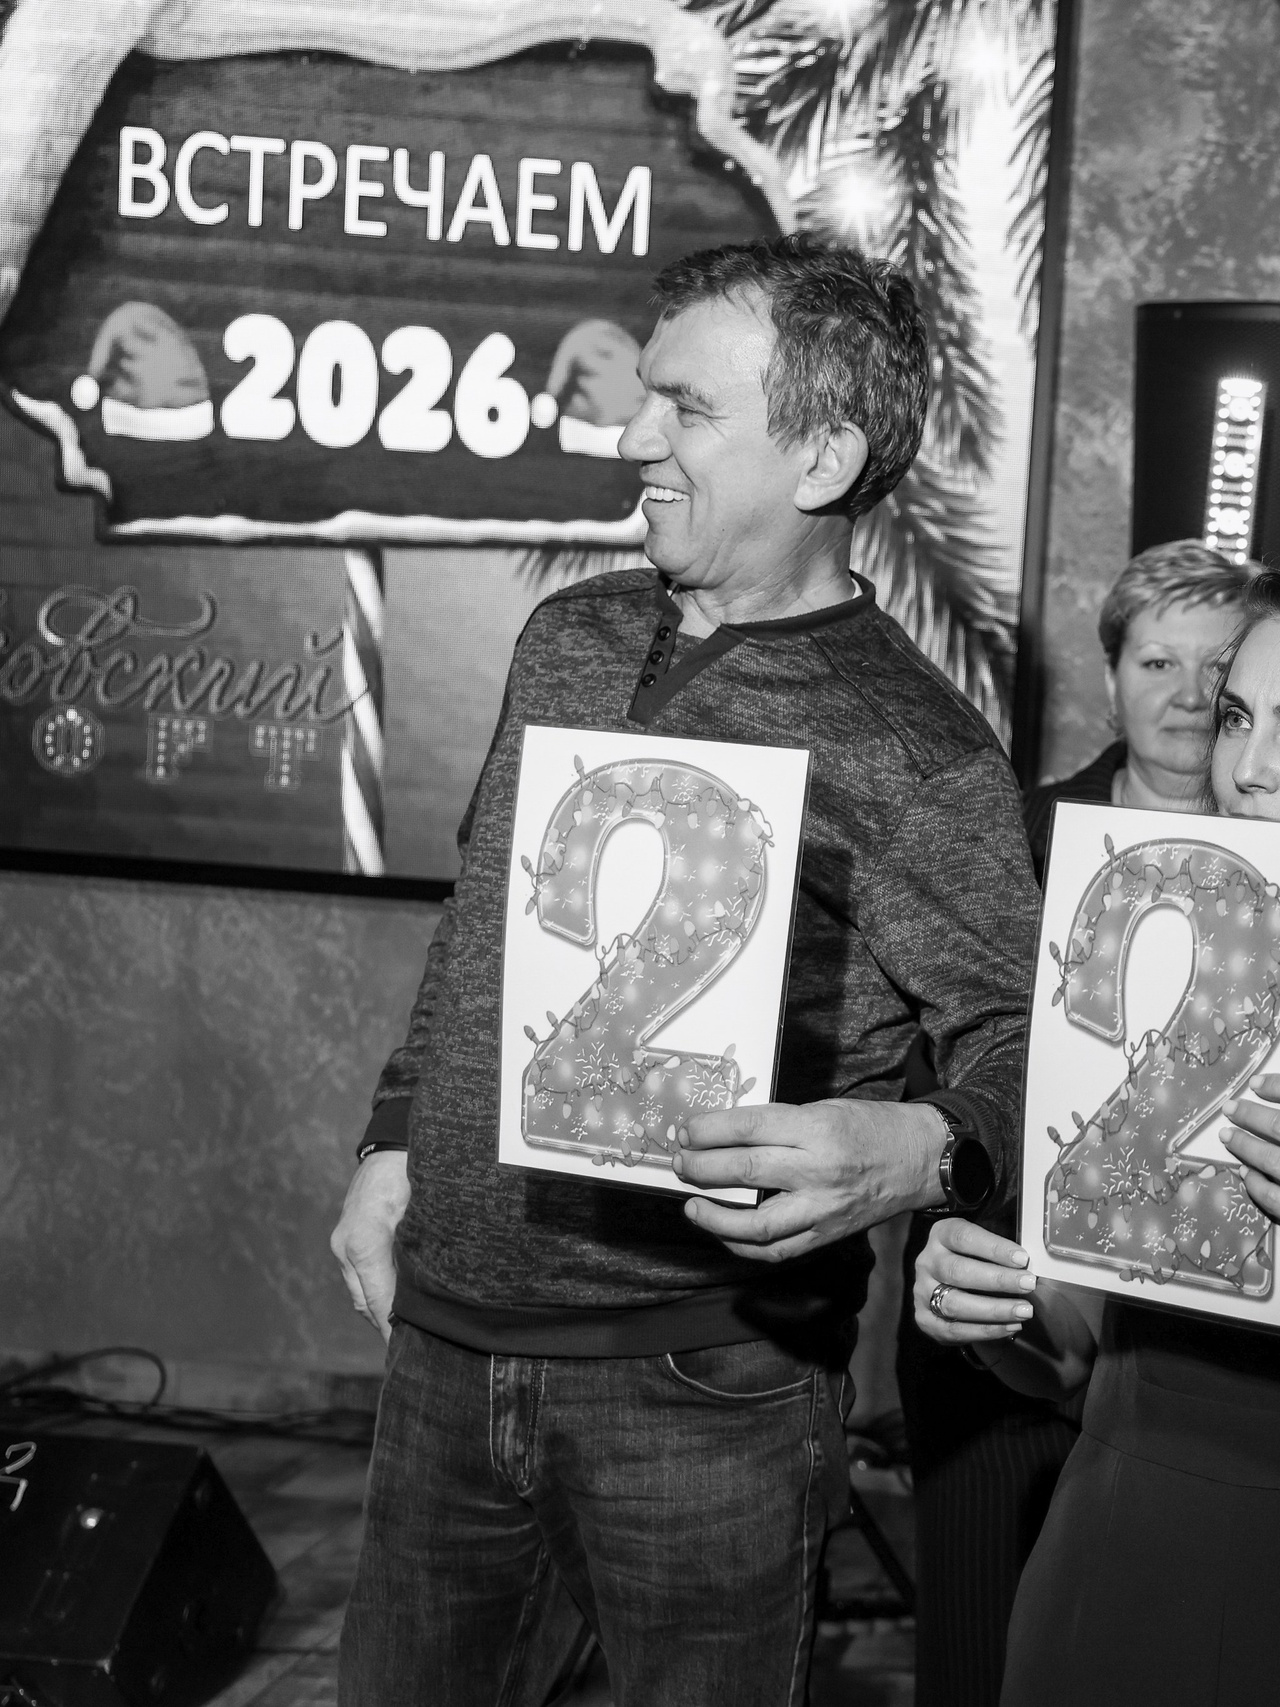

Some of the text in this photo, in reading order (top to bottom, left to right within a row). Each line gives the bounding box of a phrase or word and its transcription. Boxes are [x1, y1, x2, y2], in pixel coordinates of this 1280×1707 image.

[118, 126, 652, 256] ВСТРЕЧАЕМ
[221, 313, 531, 459] 2026
[0, 584, 362, 726] овский
[520, 757, 768, 1166] 2
